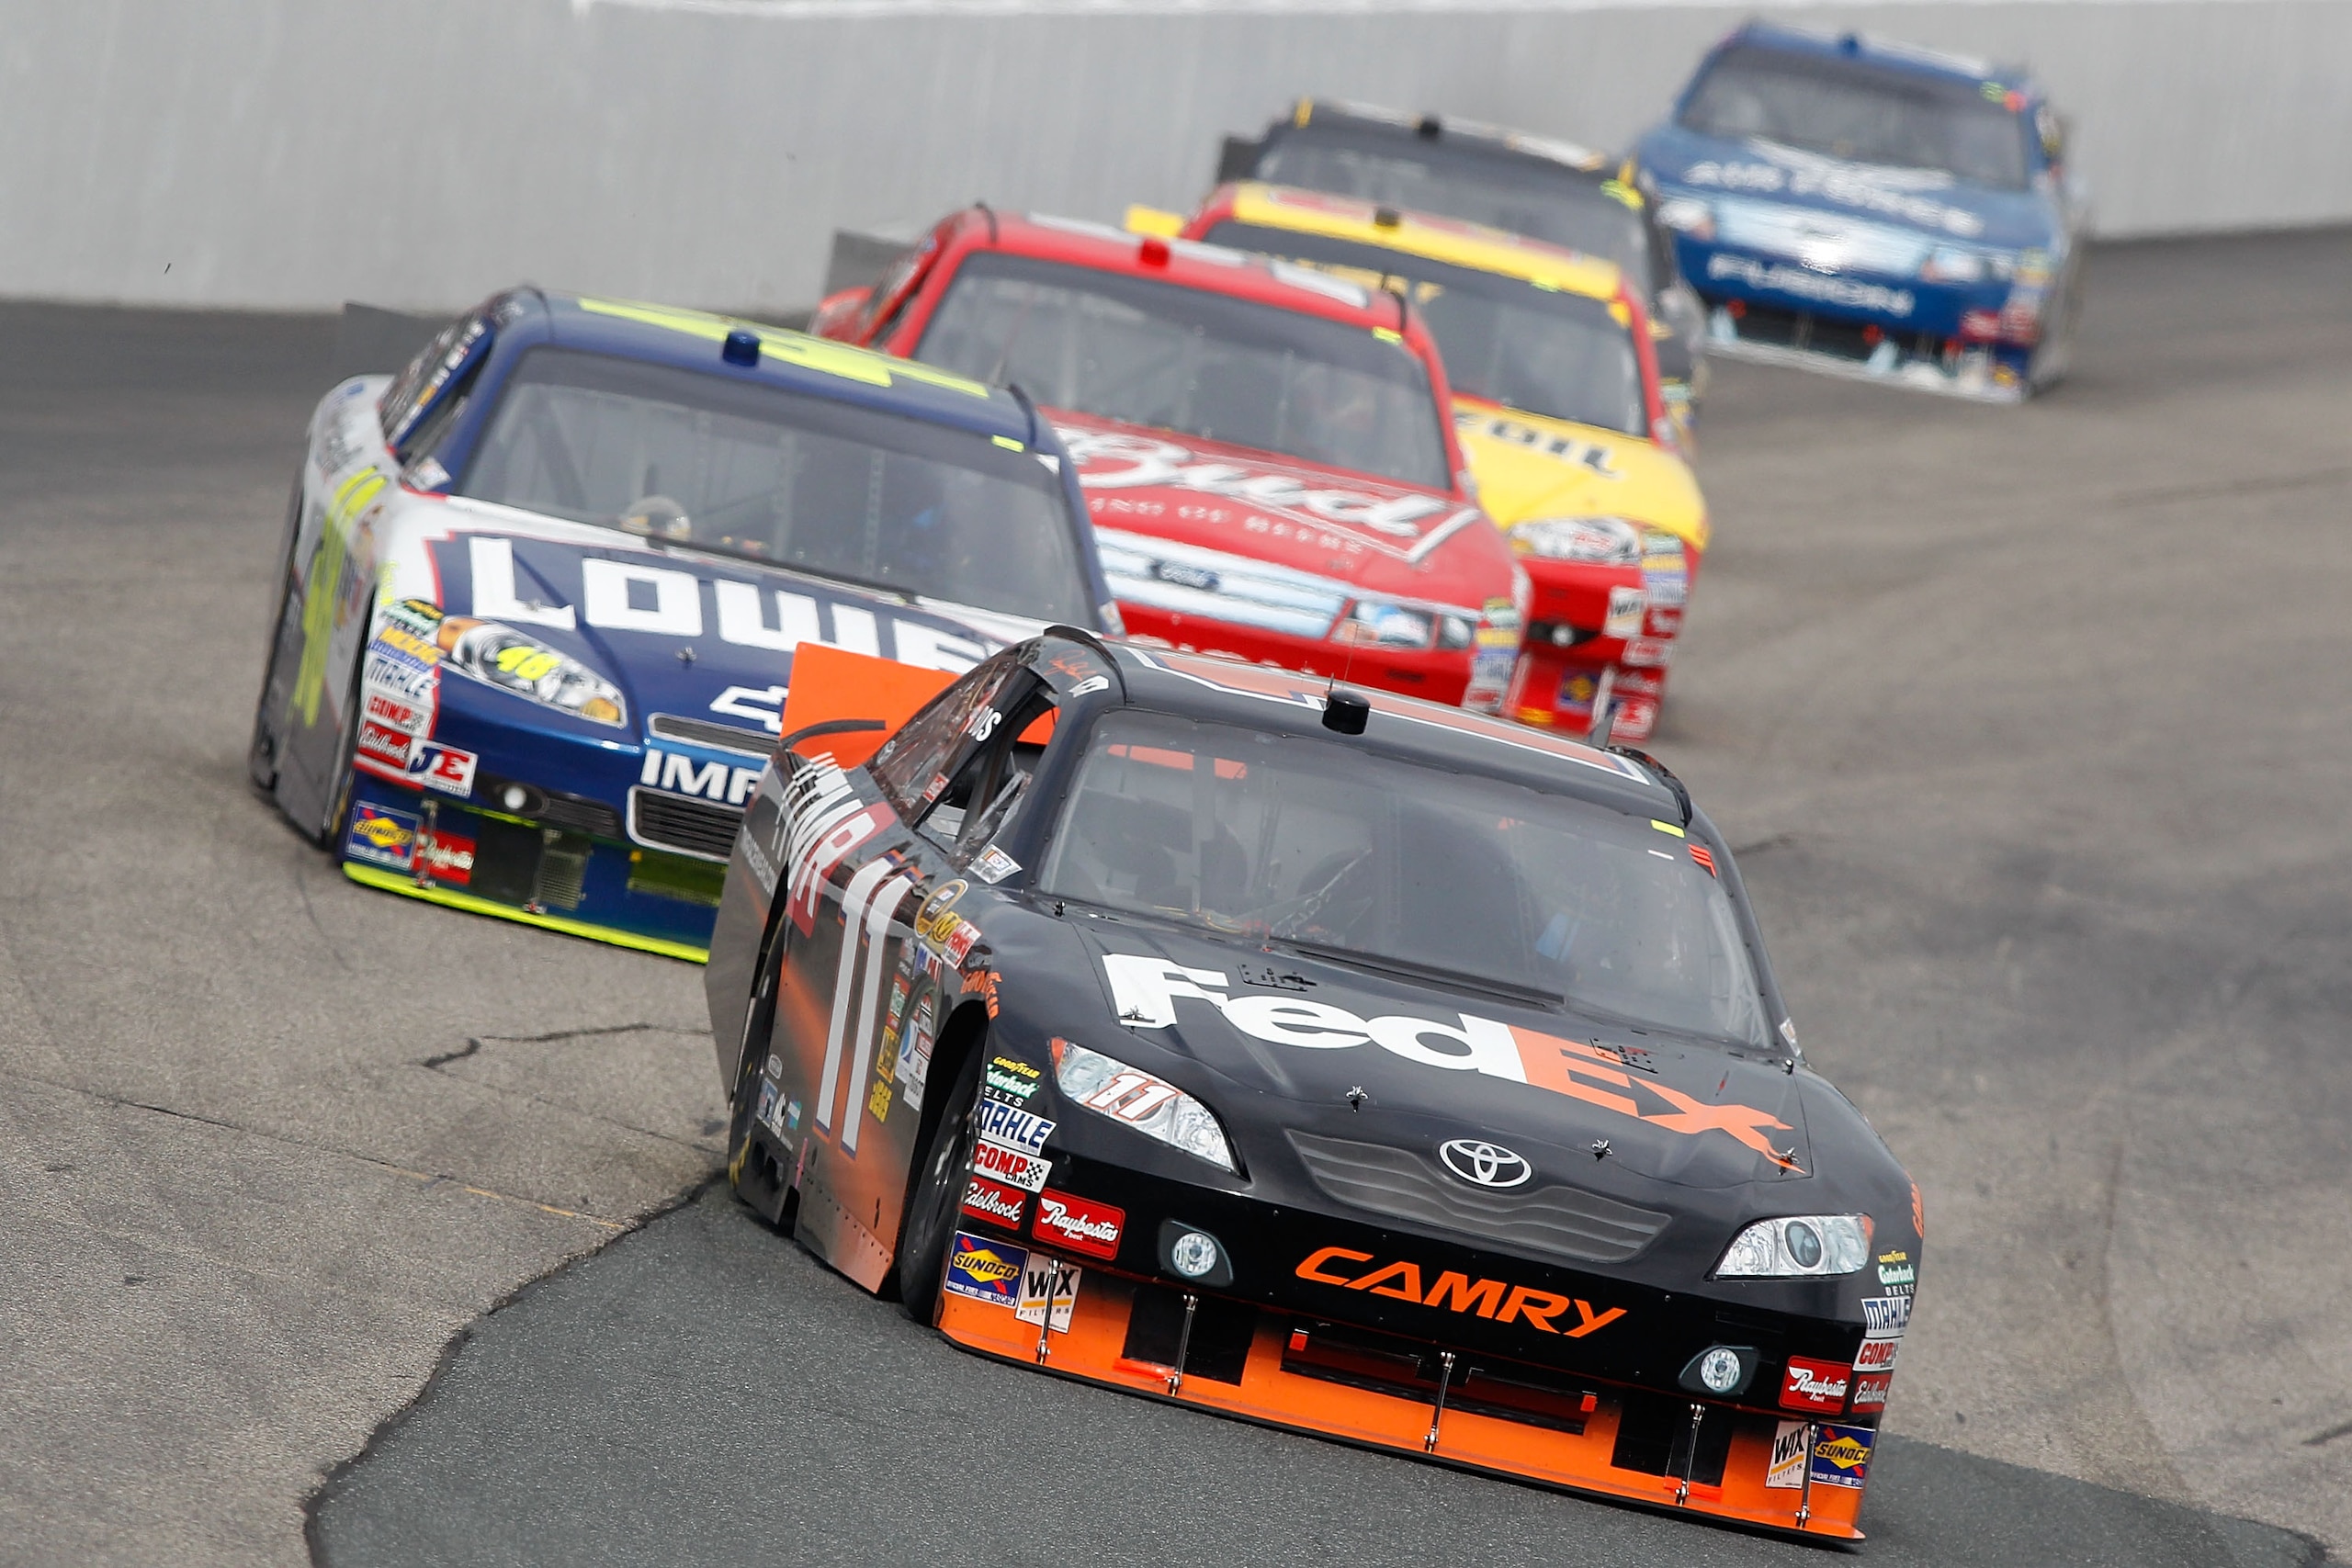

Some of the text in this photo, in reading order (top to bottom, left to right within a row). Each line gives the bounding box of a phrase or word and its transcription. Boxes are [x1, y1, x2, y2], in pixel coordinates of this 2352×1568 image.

[469, 536, 1001, 677] LOWE
[642, 749, 763, 805] IMP
[986, 1064, 1039, 1099] atorback
[1102, 953, 1806, 1174] FedEx
[984, 1086, 1024, 1107] ELTS
[1086, 1073, 1183, 1122] 11
[974, 1143, 1029, 1176] COMP
[1004, 1172, 1035, 1188] CAMS
[1040, 1197, 1120, 1242] Raybestos
[955, 1255, 1018, 1279] SUNOCO
[1295, 1247, 1628, 1339] CAMRY
[1858, 1342, 1895, 1365] COMP
[1788, 1366, 1848, 1397] Raybestos
[1774, 1423, 1809, 1464] WIX
